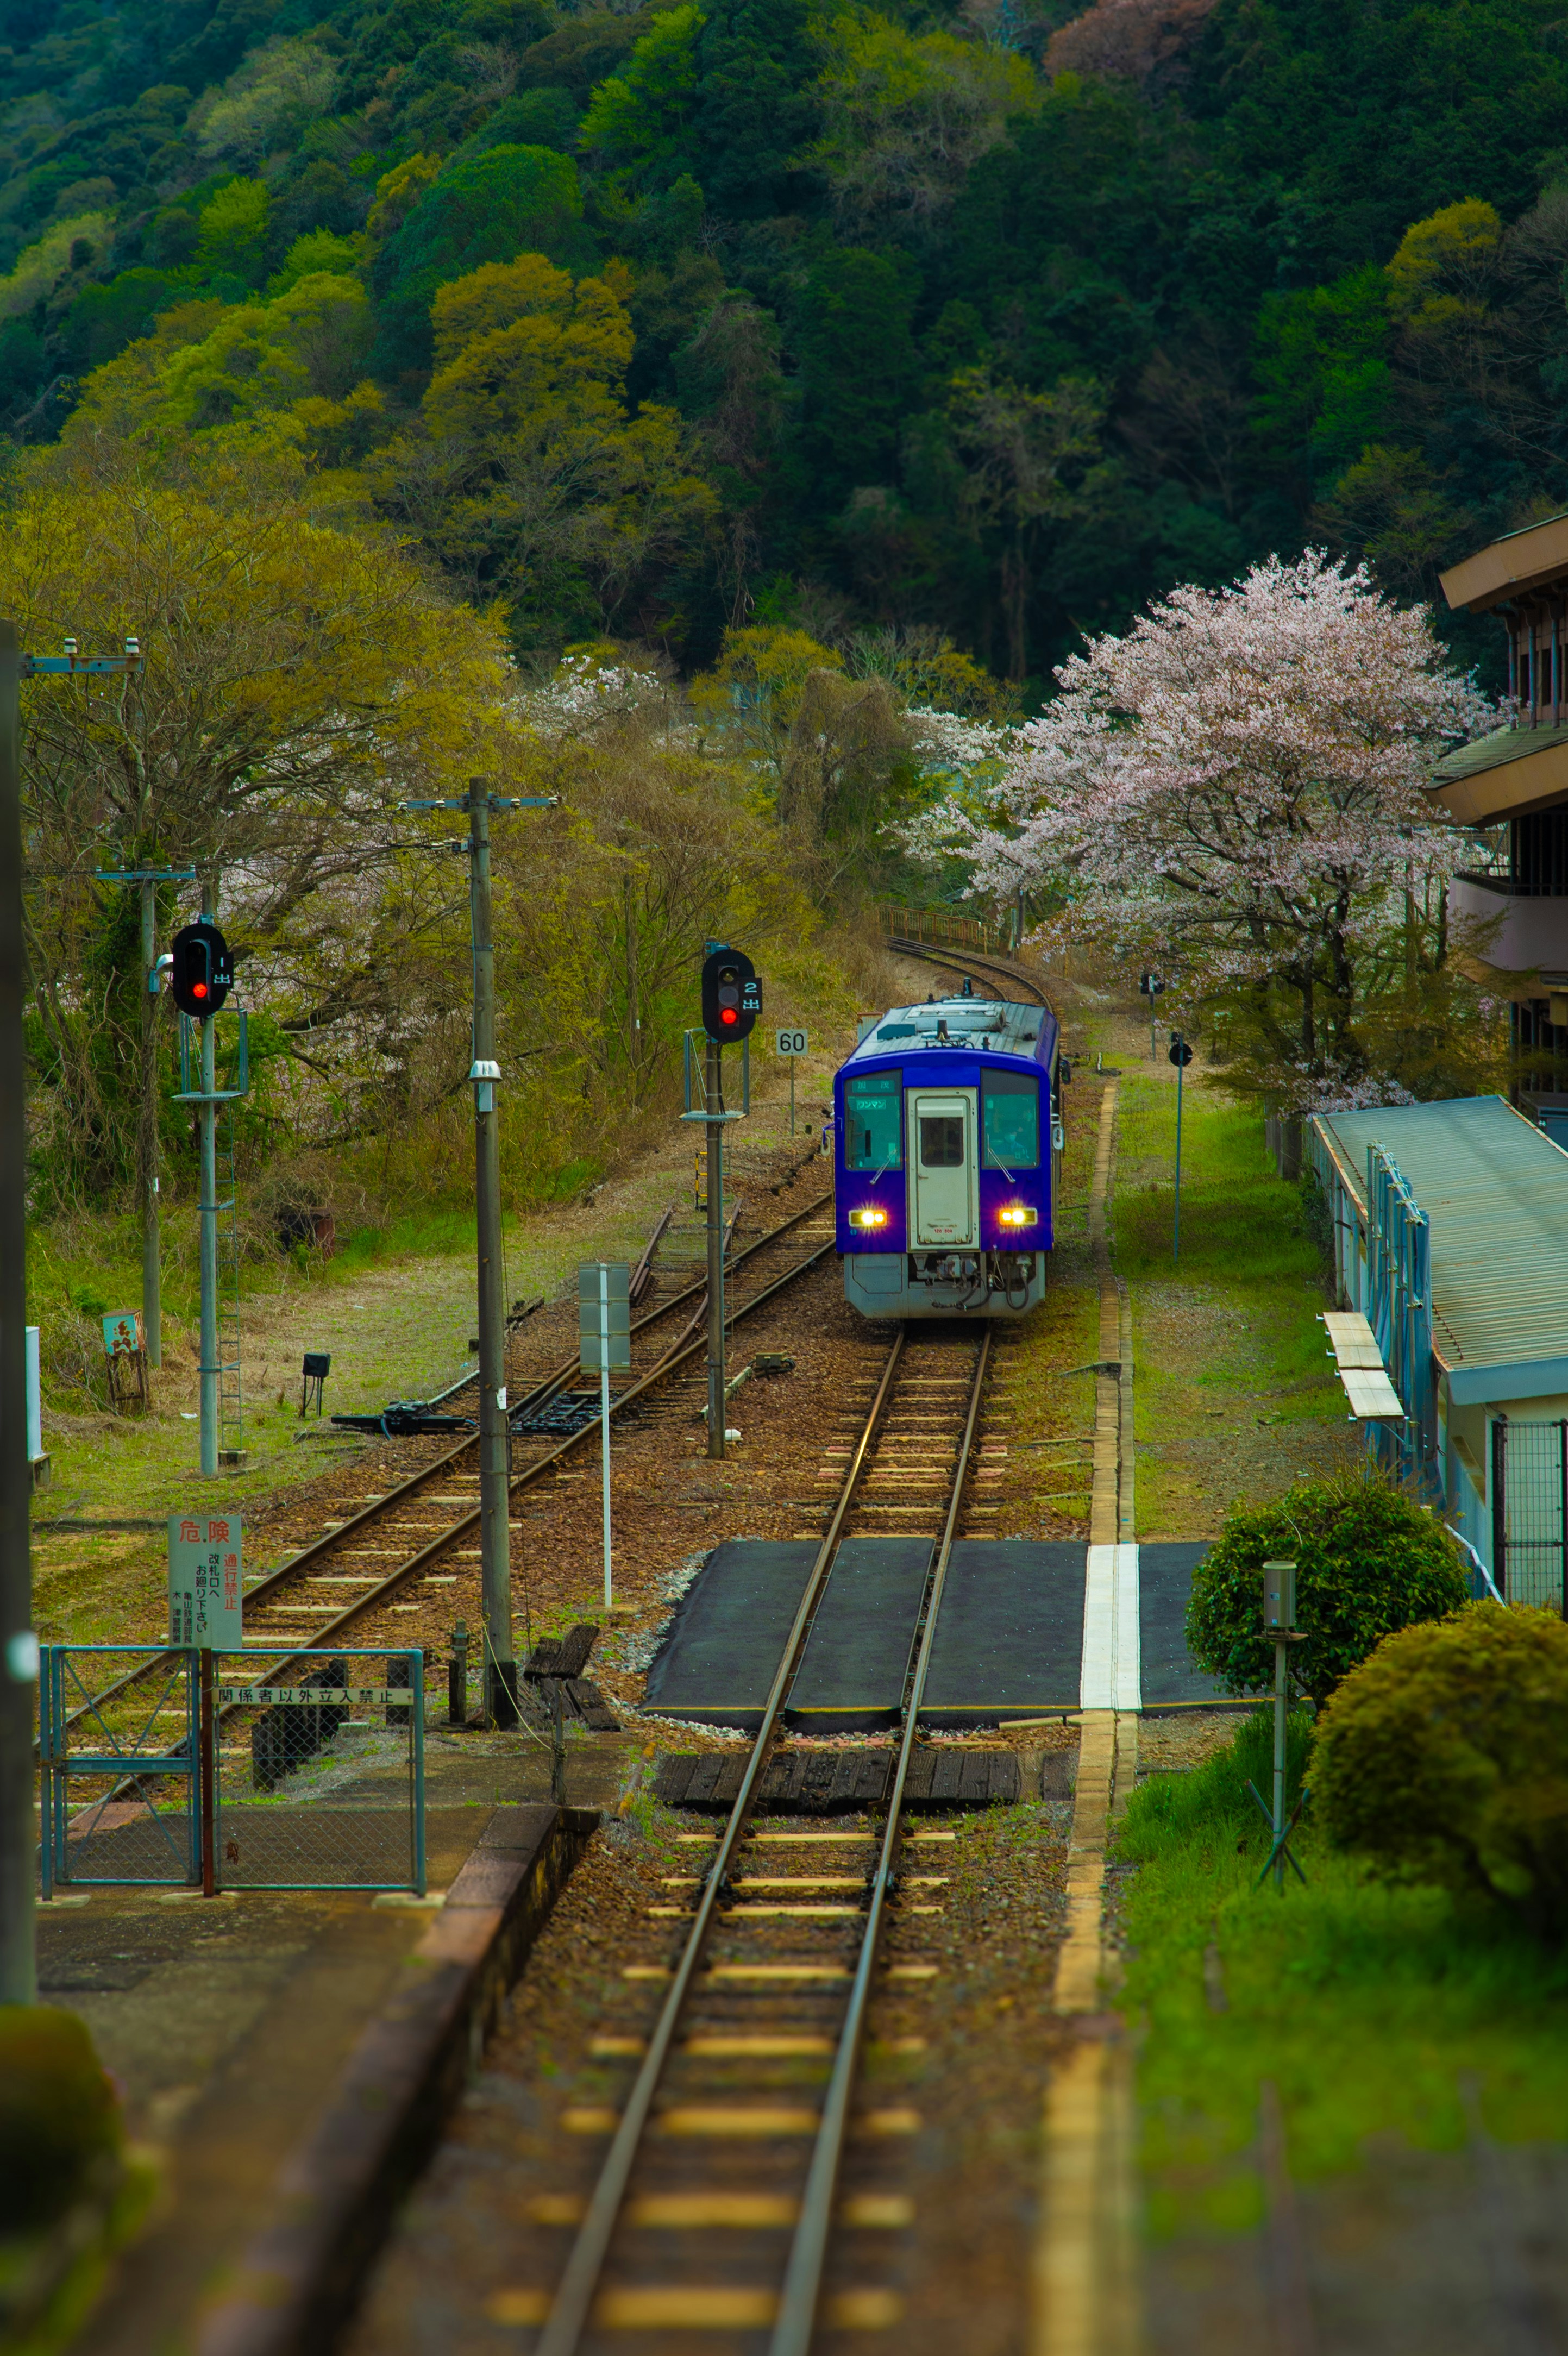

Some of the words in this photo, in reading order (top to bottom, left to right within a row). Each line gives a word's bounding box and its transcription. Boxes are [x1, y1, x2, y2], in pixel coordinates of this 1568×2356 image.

[780, 1033, 805, 1051] 60
[858, 1100, 885, 1108] ワンマン
[179, 1520, 230, 1543] 危険
[209, 1554, 219, 1597] 改札口へ
[224, 1553, 237, 1611] 通行禁止
[196, 1565, 206, 1633] お廻り下さい
[184, 1591, 192, 1643] 亀山鉄道部長
[218, 1690, 393, 1703] 関係者以外立入禁止
